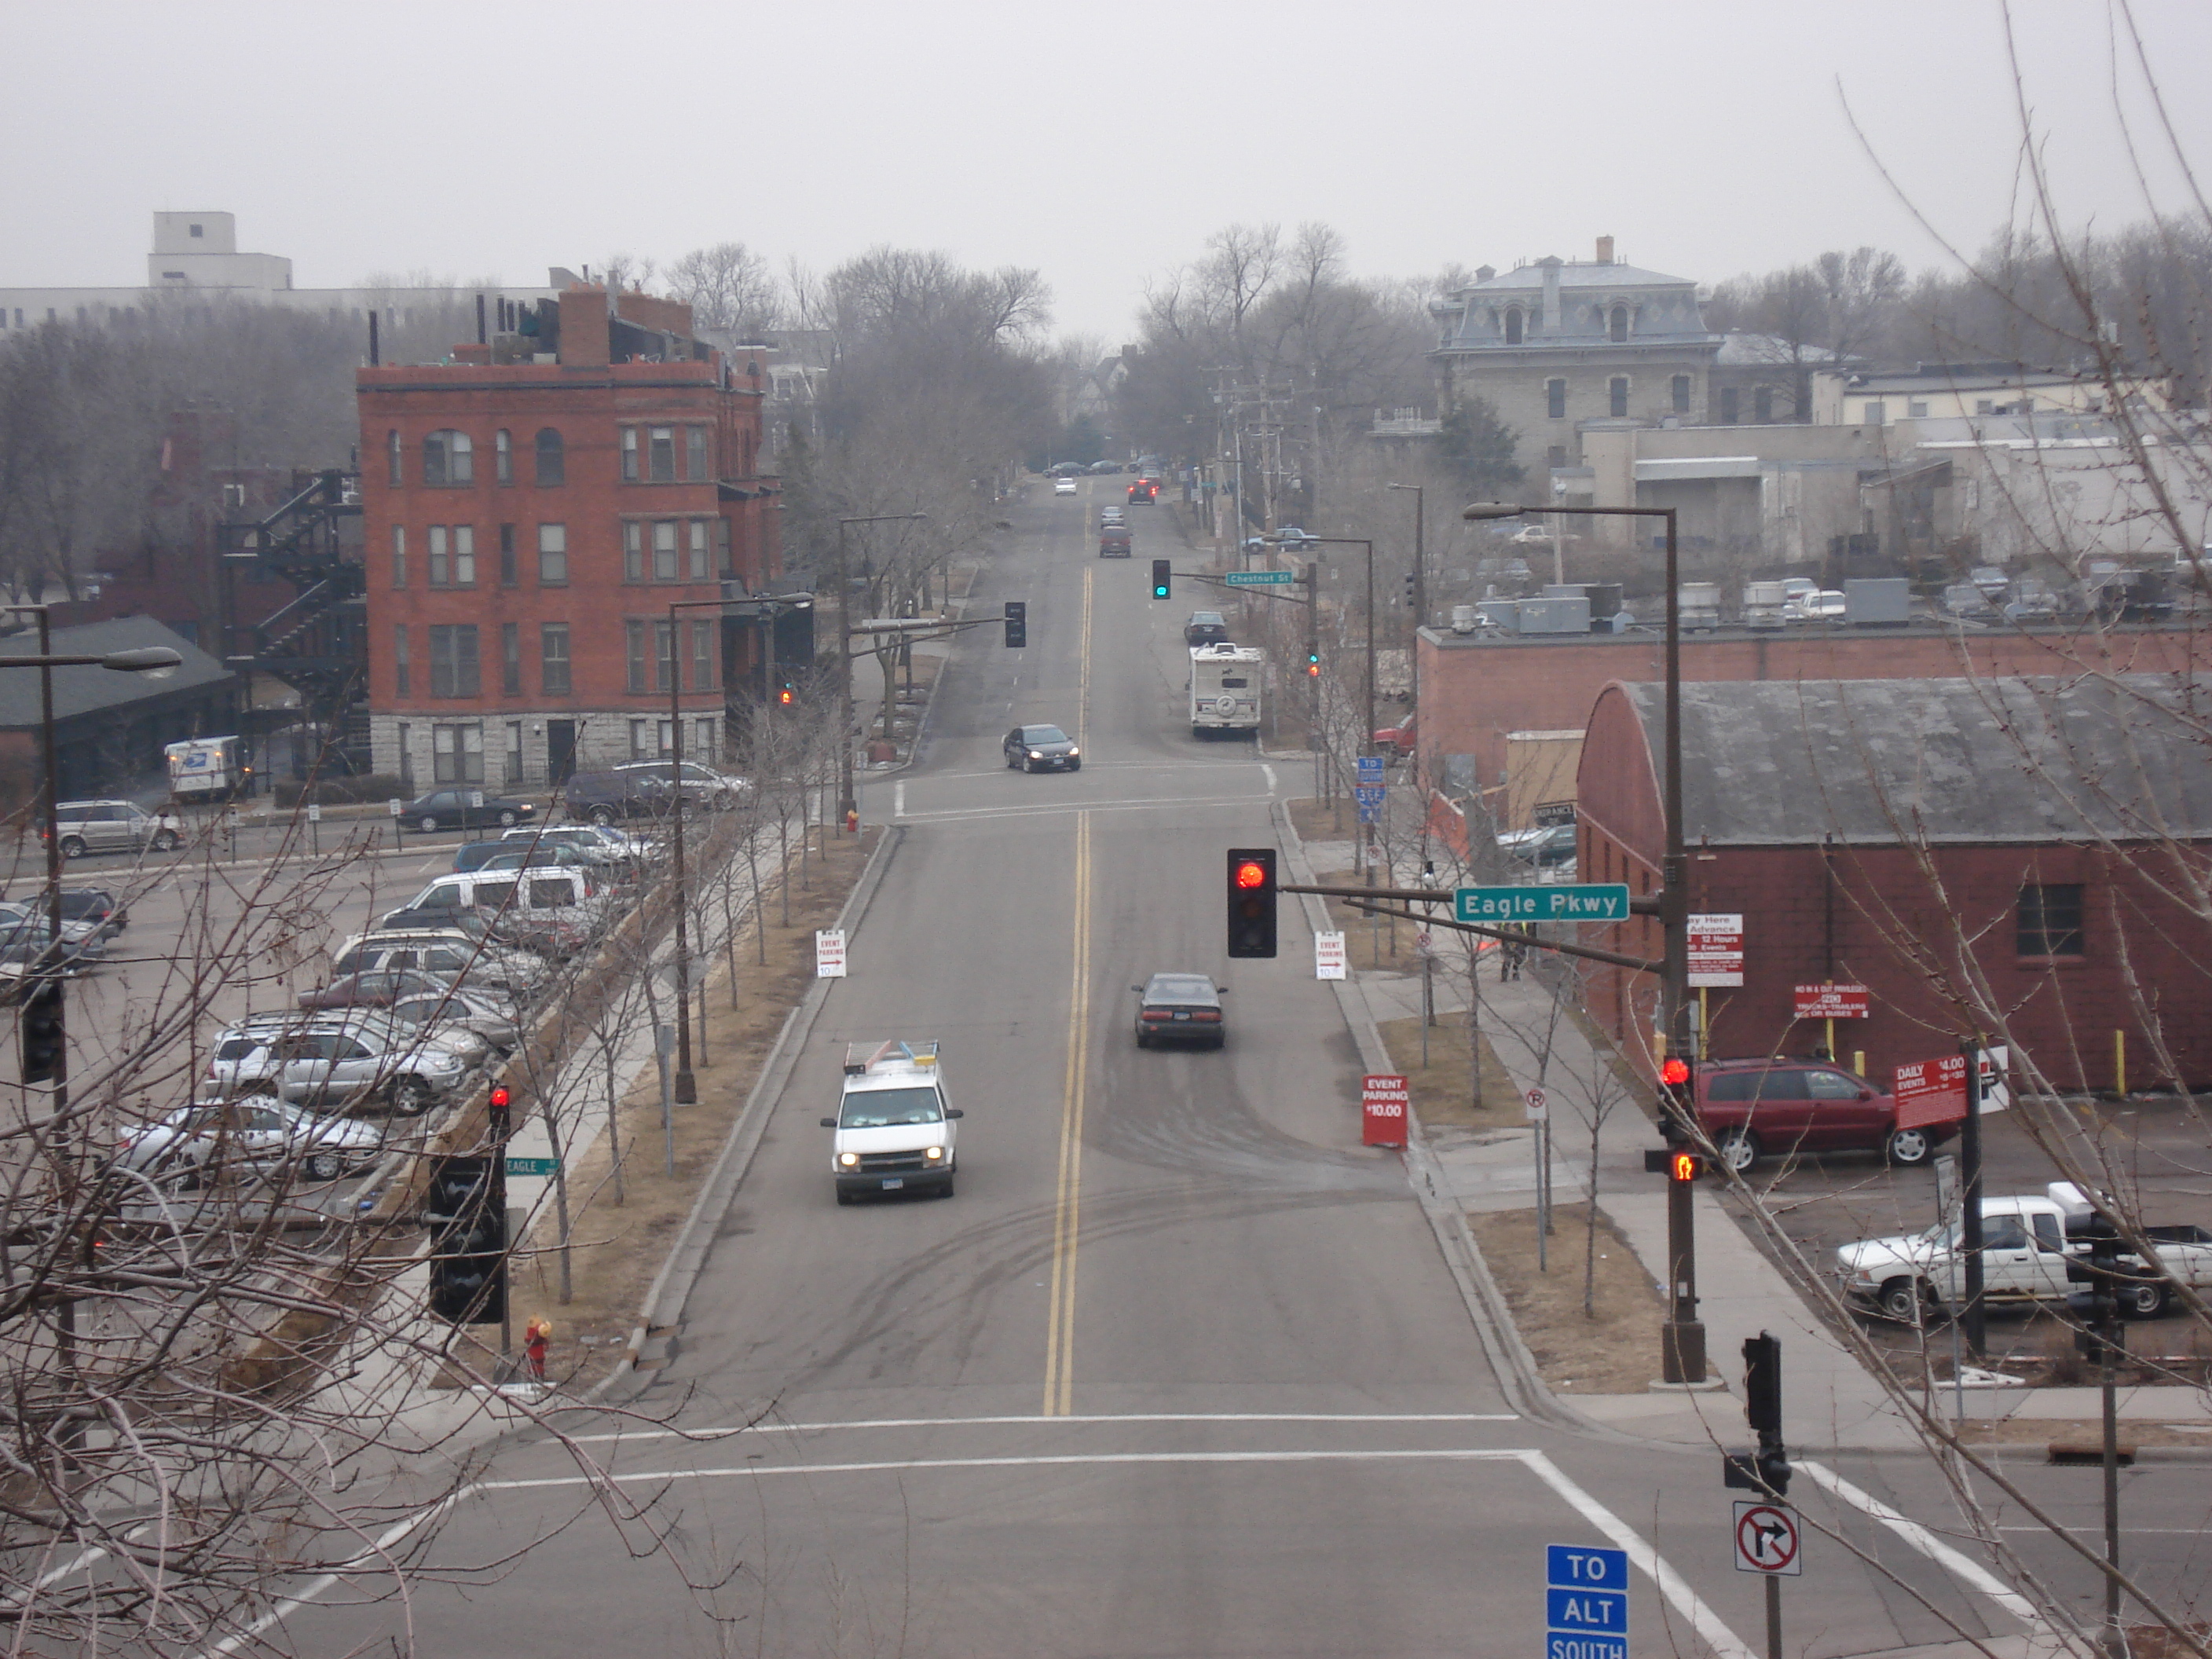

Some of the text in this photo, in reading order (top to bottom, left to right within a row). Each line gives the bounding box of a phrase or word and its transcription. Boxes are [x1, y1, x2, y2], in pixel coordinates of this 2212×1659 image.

[1465, 892, 1618, 919] Eagle Pkwy
[820, 967, 830, 976] 10
[1320, 968, 1330, 976] 10
[1939, 1057, 1965, 1071] $4.00
[1896, 1064, 1925, 1080] DAILY
[1368, 1079, 1402, 1090] EVENT
[1897, 1077, 1926, 1091] EVENTS
[1362, 1090, 1408, 1101] PARKING
[1367, 1104, 1402, 1117] $10.00
[507, 1160, 537, 1173] EAGLE
[1566, 1555, 1606, 1580] TO
[1563, 1598, 1613, 1624] ALT
[1551, 1639, 1623, 1659] SOUTH
